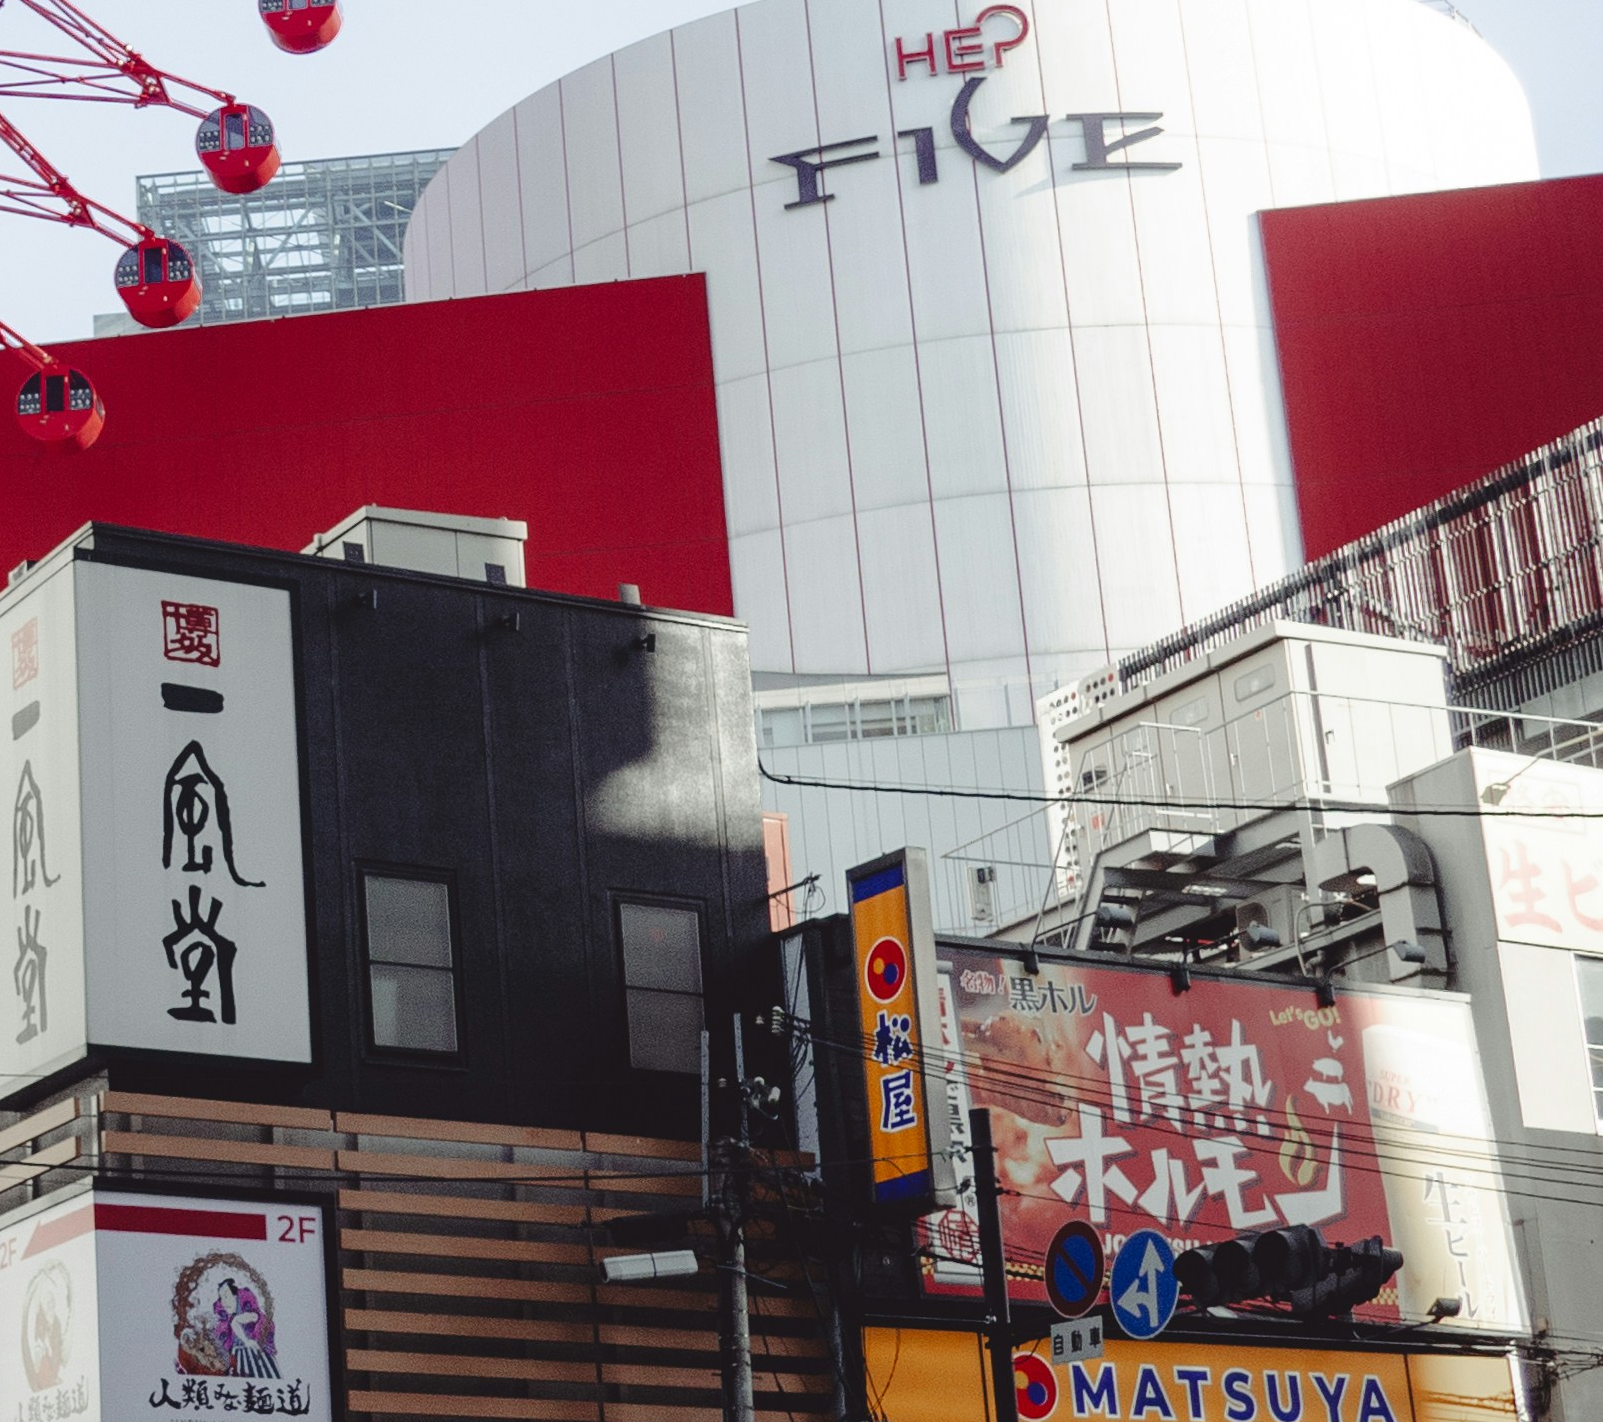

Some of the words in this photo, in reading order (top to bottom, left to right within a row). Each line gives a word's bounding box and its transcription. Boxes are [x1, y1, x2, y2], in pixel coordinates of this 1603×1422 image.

[894, 4, 1029, 80] HEP
[768, 77, 1182, 210] FIVE
[11, 700, 61, 1045] 一風堂
[161, 682, 266, 1024] 一風堂
[1009, 976, 1098, 1014] 黒ホル
[1303, 1004, 1342, 1030] GO!
[871, 1011, 916, 1133] 松屋
[1086, 1011, 1274, 1135] 情熱
[1041, 1103, 1344, 1230] ホルモン
[0, 1237, 18, 1270] 2F
[278, 1216, 316, 1244] 2F
[1053, 1327, 1101, 1357] 自動車
